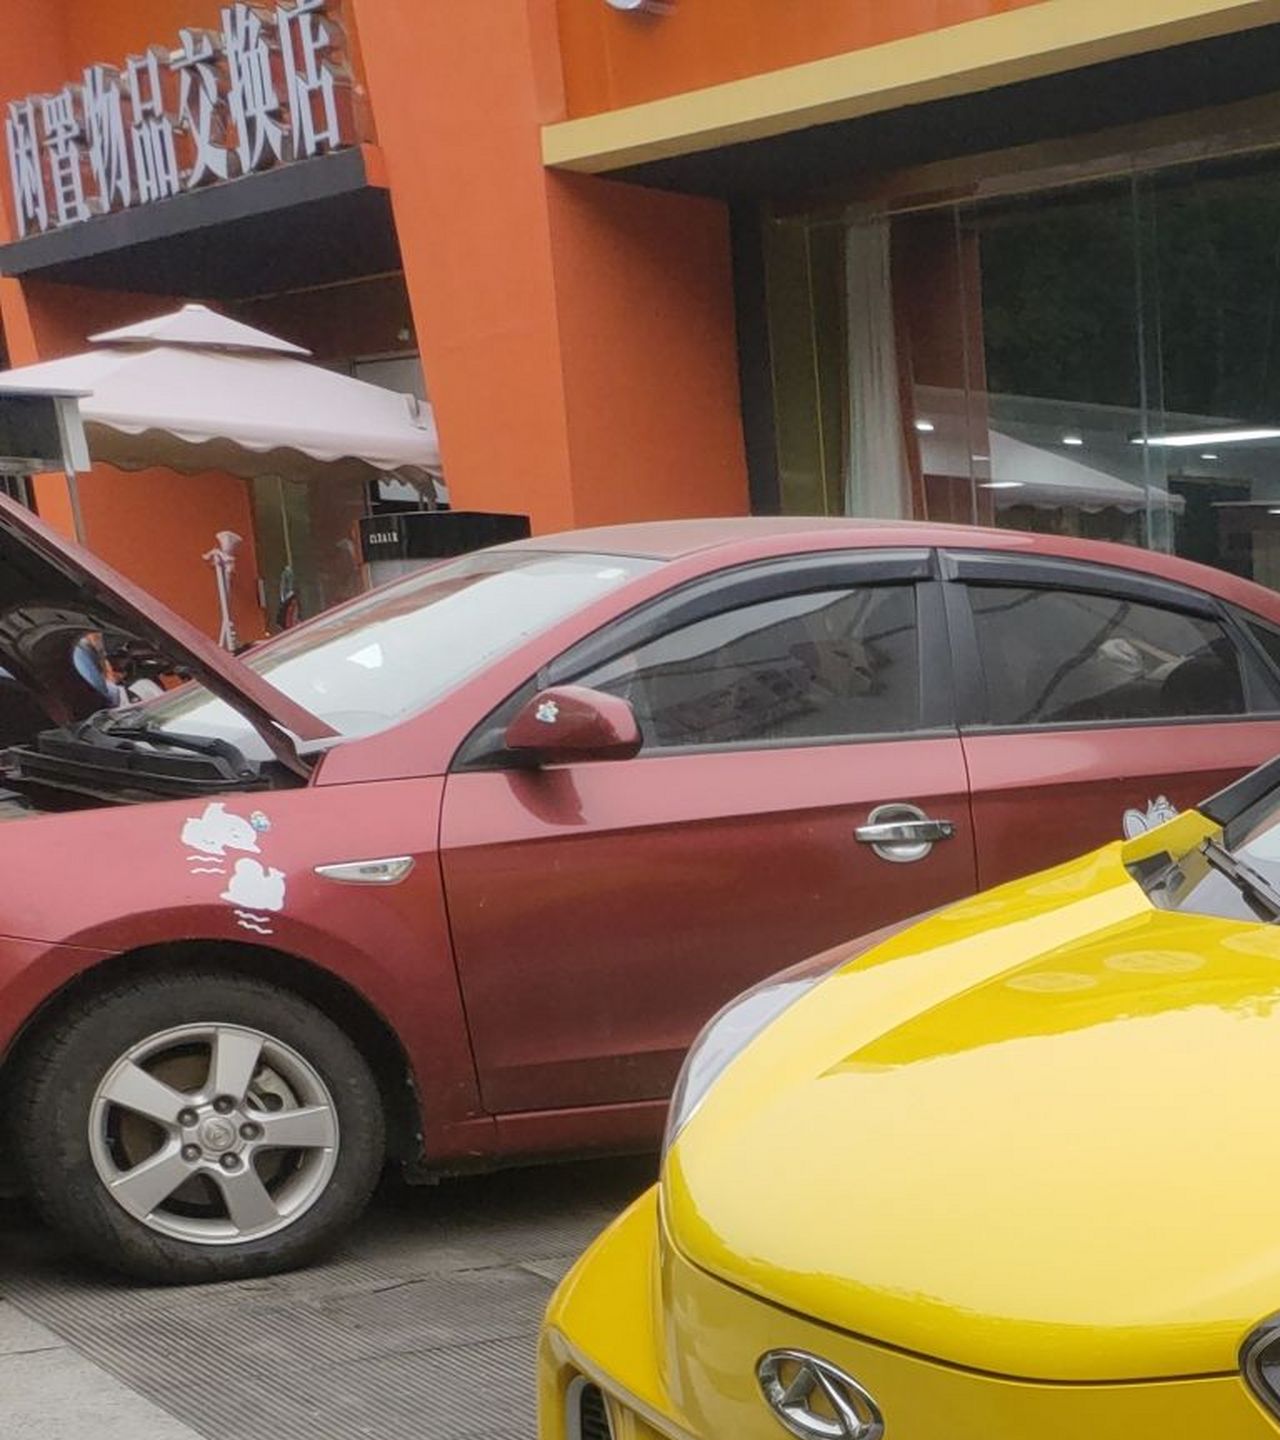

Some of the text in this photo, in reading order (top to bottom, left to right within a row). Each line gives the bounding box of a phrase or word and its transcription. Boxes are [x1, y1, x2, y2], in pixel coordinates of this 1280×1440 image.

[5, 0, 342, 237] 闲置物品交换店
